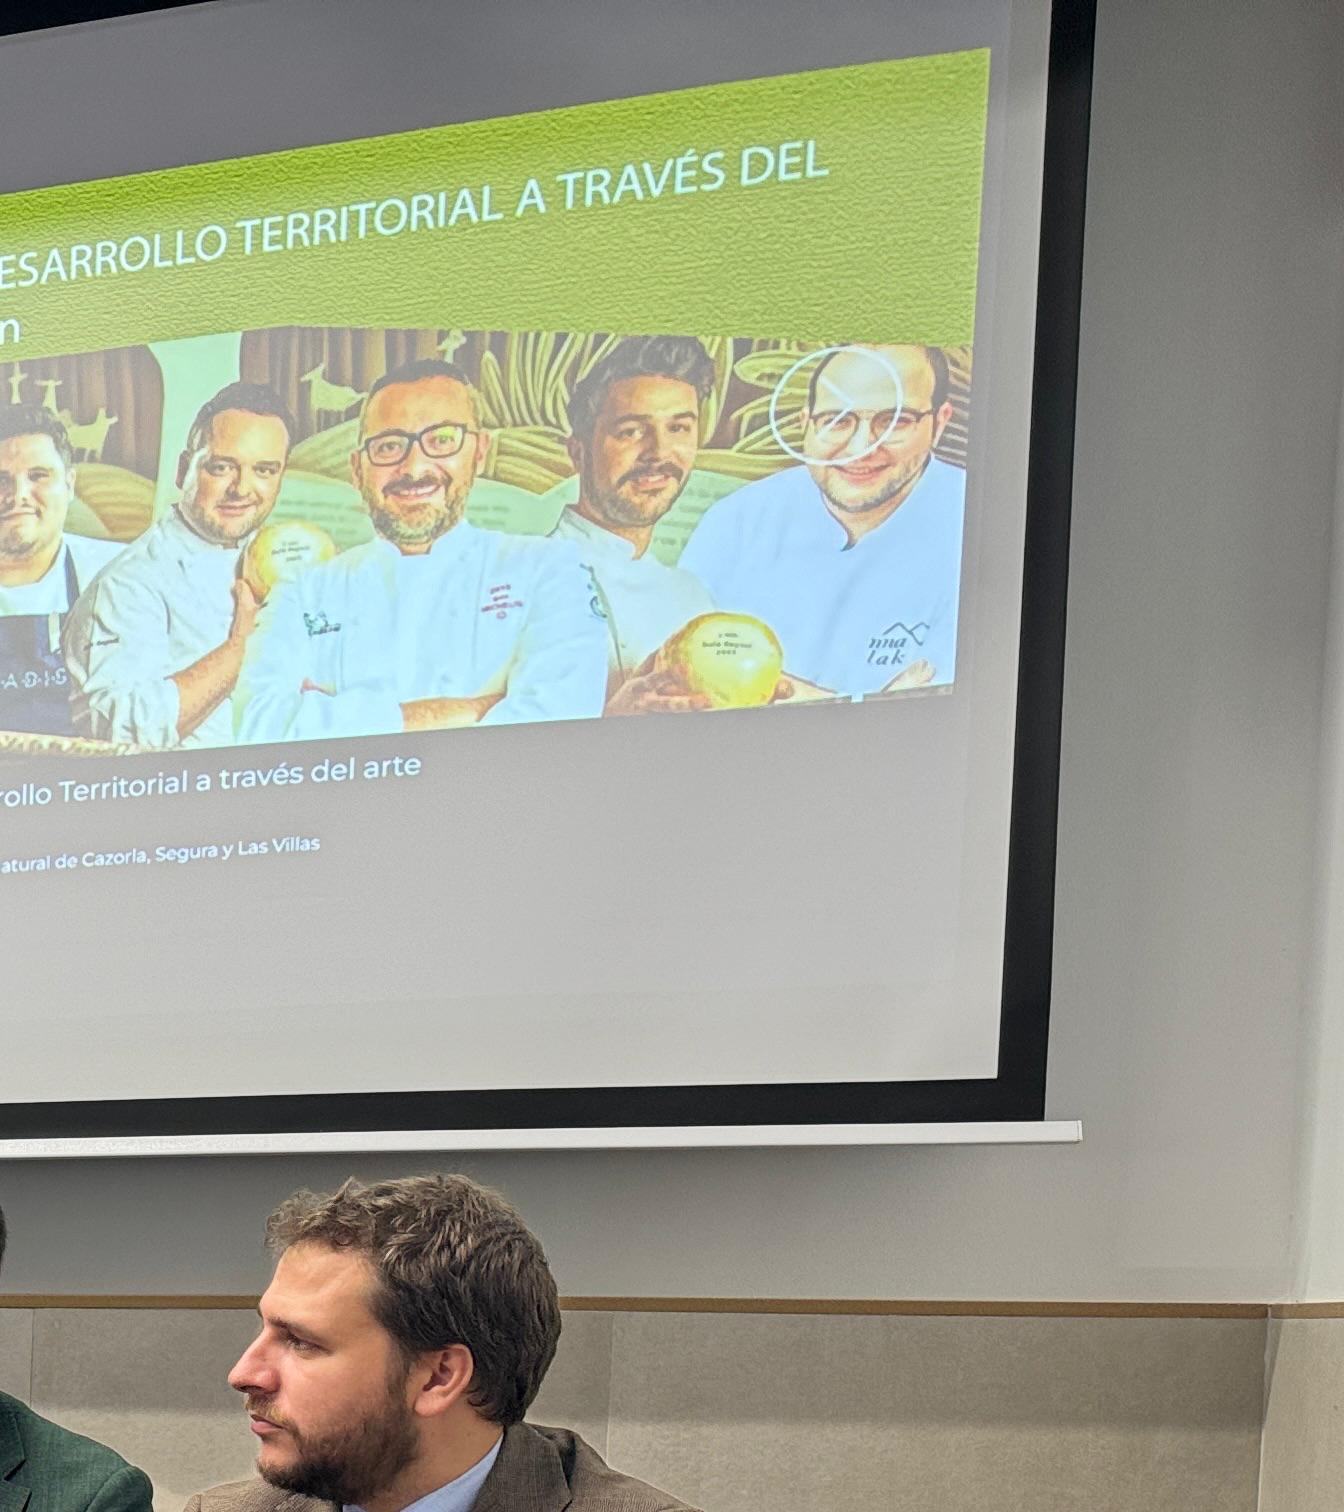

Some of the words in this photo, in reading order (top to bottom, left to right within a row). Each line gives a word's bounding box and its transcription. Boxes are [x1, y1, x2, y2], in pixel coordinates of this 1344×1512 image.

[235, 184, 504, 256] TERRITORIAL
[516, 178, 546, 217] A
[557, 149, 726, 209] TRAVÉS
[740, 139, 830, 187] DEL
[58, 770, 188, 802] Territorial
[196, 773, 211, 791] a
[220, 762, 303, 790] través
[311, 757, 354, 782] del
[364, 757, 421, 779] arte
[55, 853, 78, 869] de
[82, 849, 151, 868] Cazorla,
[156, 843, 217, 864] Segura
[222, 844, 234, 860] y
[238, 841, 267, 855] Las
[272, 836, 320, 852] Villas
